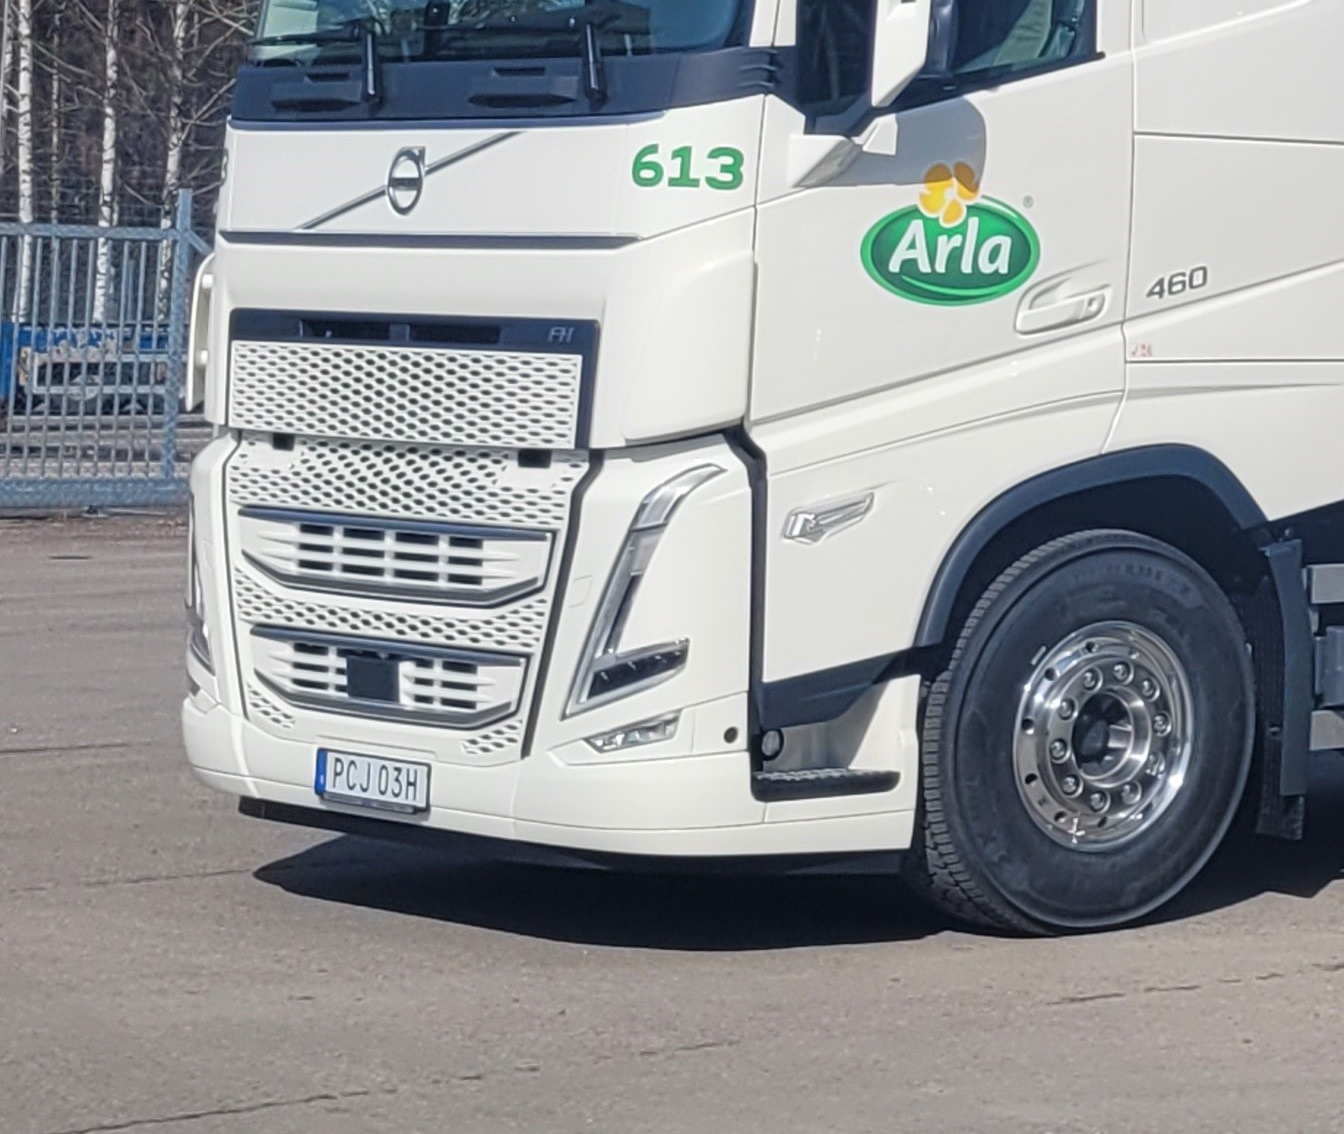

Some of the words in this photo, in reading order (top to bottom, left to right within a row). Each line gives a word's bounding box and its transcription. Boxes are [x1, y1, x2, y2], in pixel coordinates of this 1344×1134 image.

[631, 143, 745, 191] 613
[888, 216, 1012, 275] Arla
[1145, 265, 1208, 300] 460
[332, 756, 371, 793] PCJ
[378, 764, 418, 801] 03H
